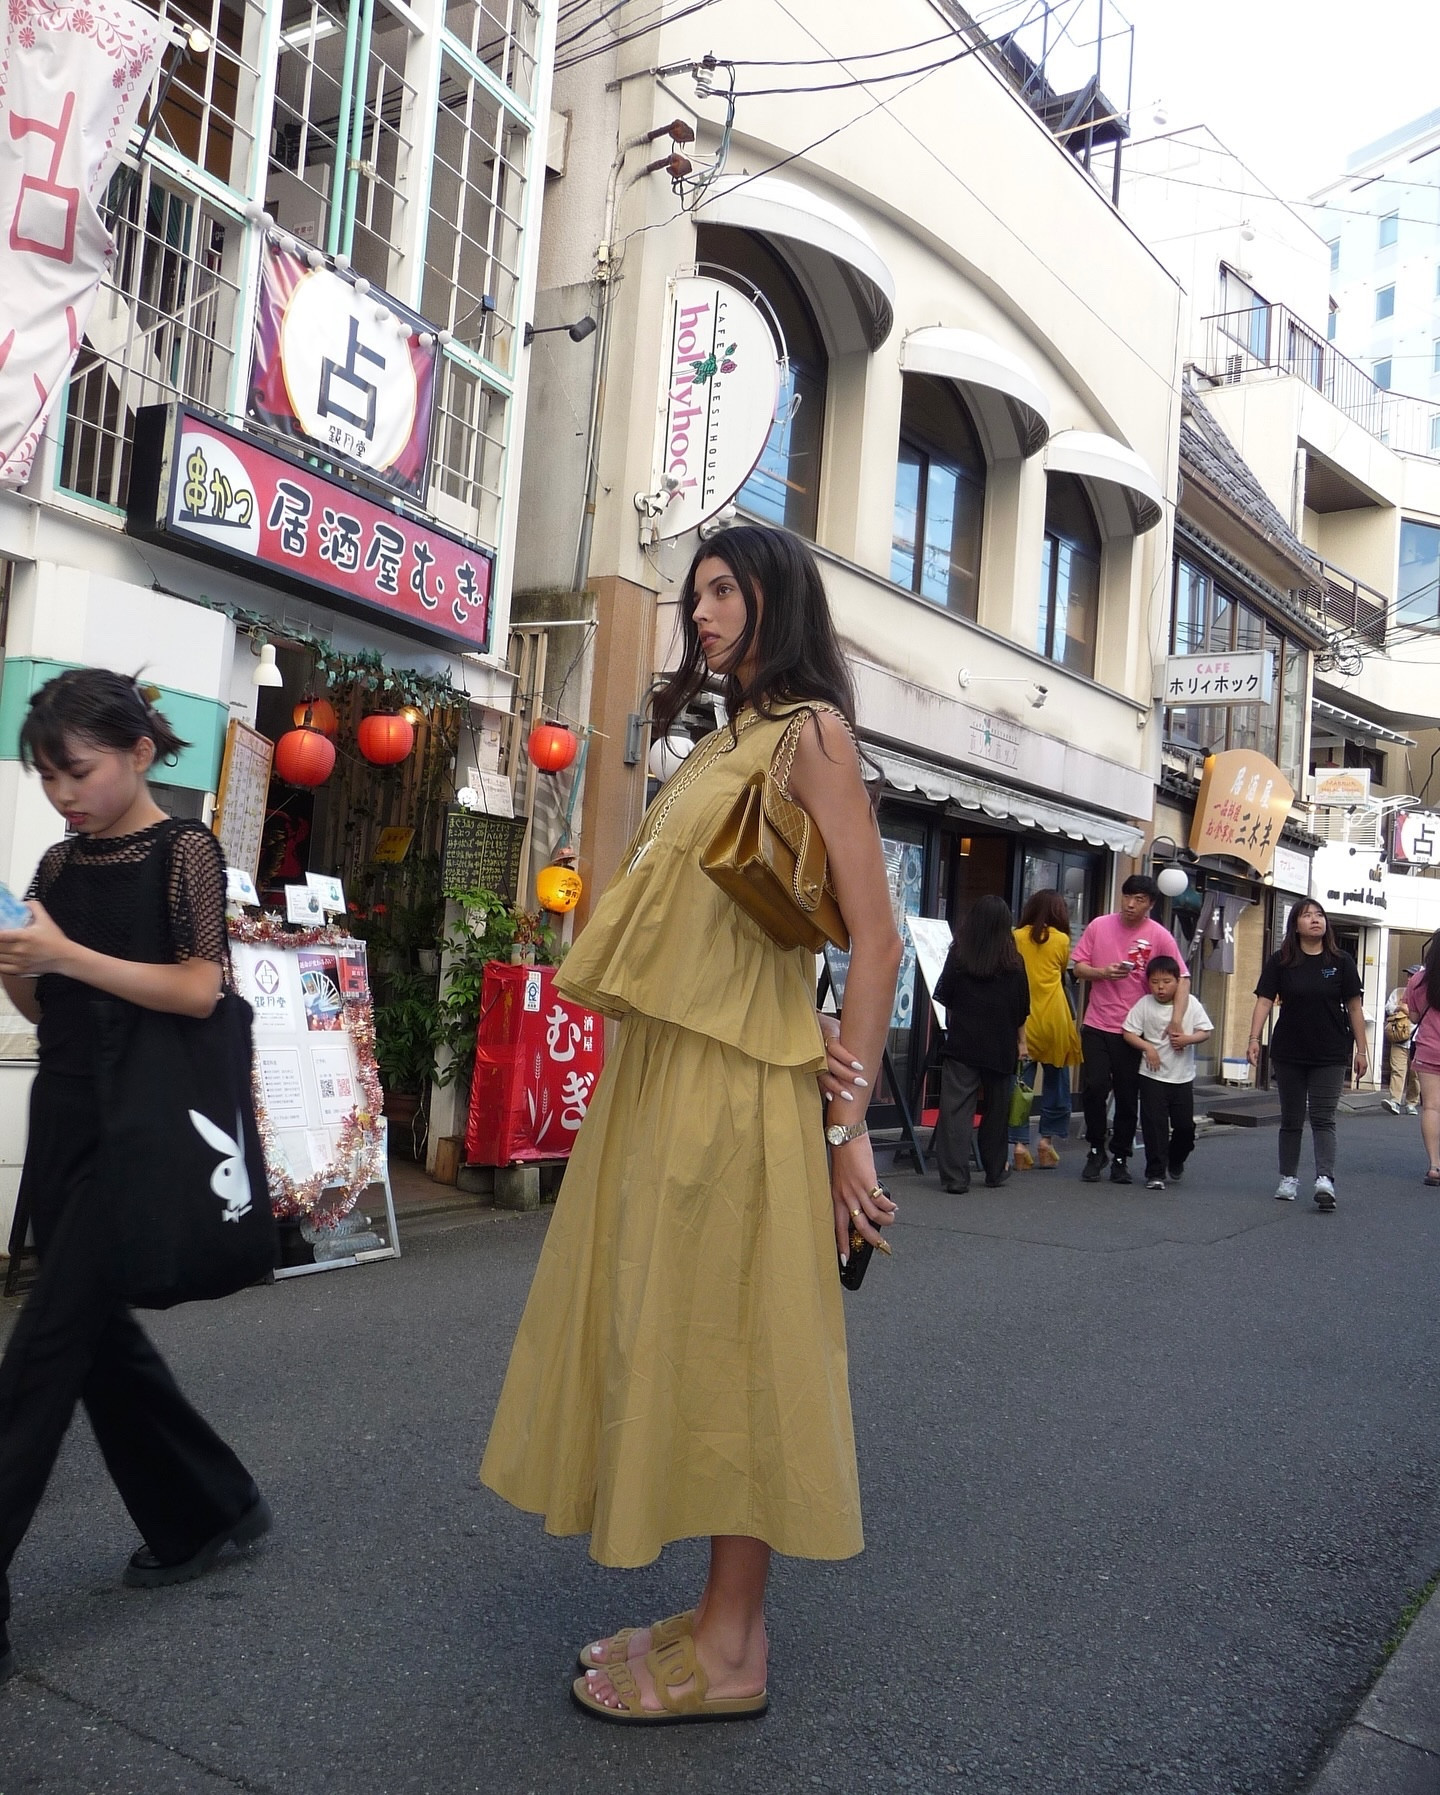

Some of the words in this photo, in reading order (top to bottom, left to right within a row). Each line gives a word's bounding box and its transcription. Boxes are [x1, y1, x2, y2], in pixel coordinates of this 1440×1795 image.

[716, 302, 728, 349] CAFE
[317, 315, 386, 441] 占
[667, 302, 710, 508] hollyhock
[329, 425, 366, 458] 銀月堂
[184, 446, 252, 524] 串かつ
[268, 479, 483, 623] 居酒屋むぎ
[1197, 662, 1230, 674] CAFE
[1413, 823, 1435, 857] 占
[261, 964, 273, 985] 占
[583, 1014, 595, 1052] 酒屋
[546, 1004, 595, 1131] むぎ
